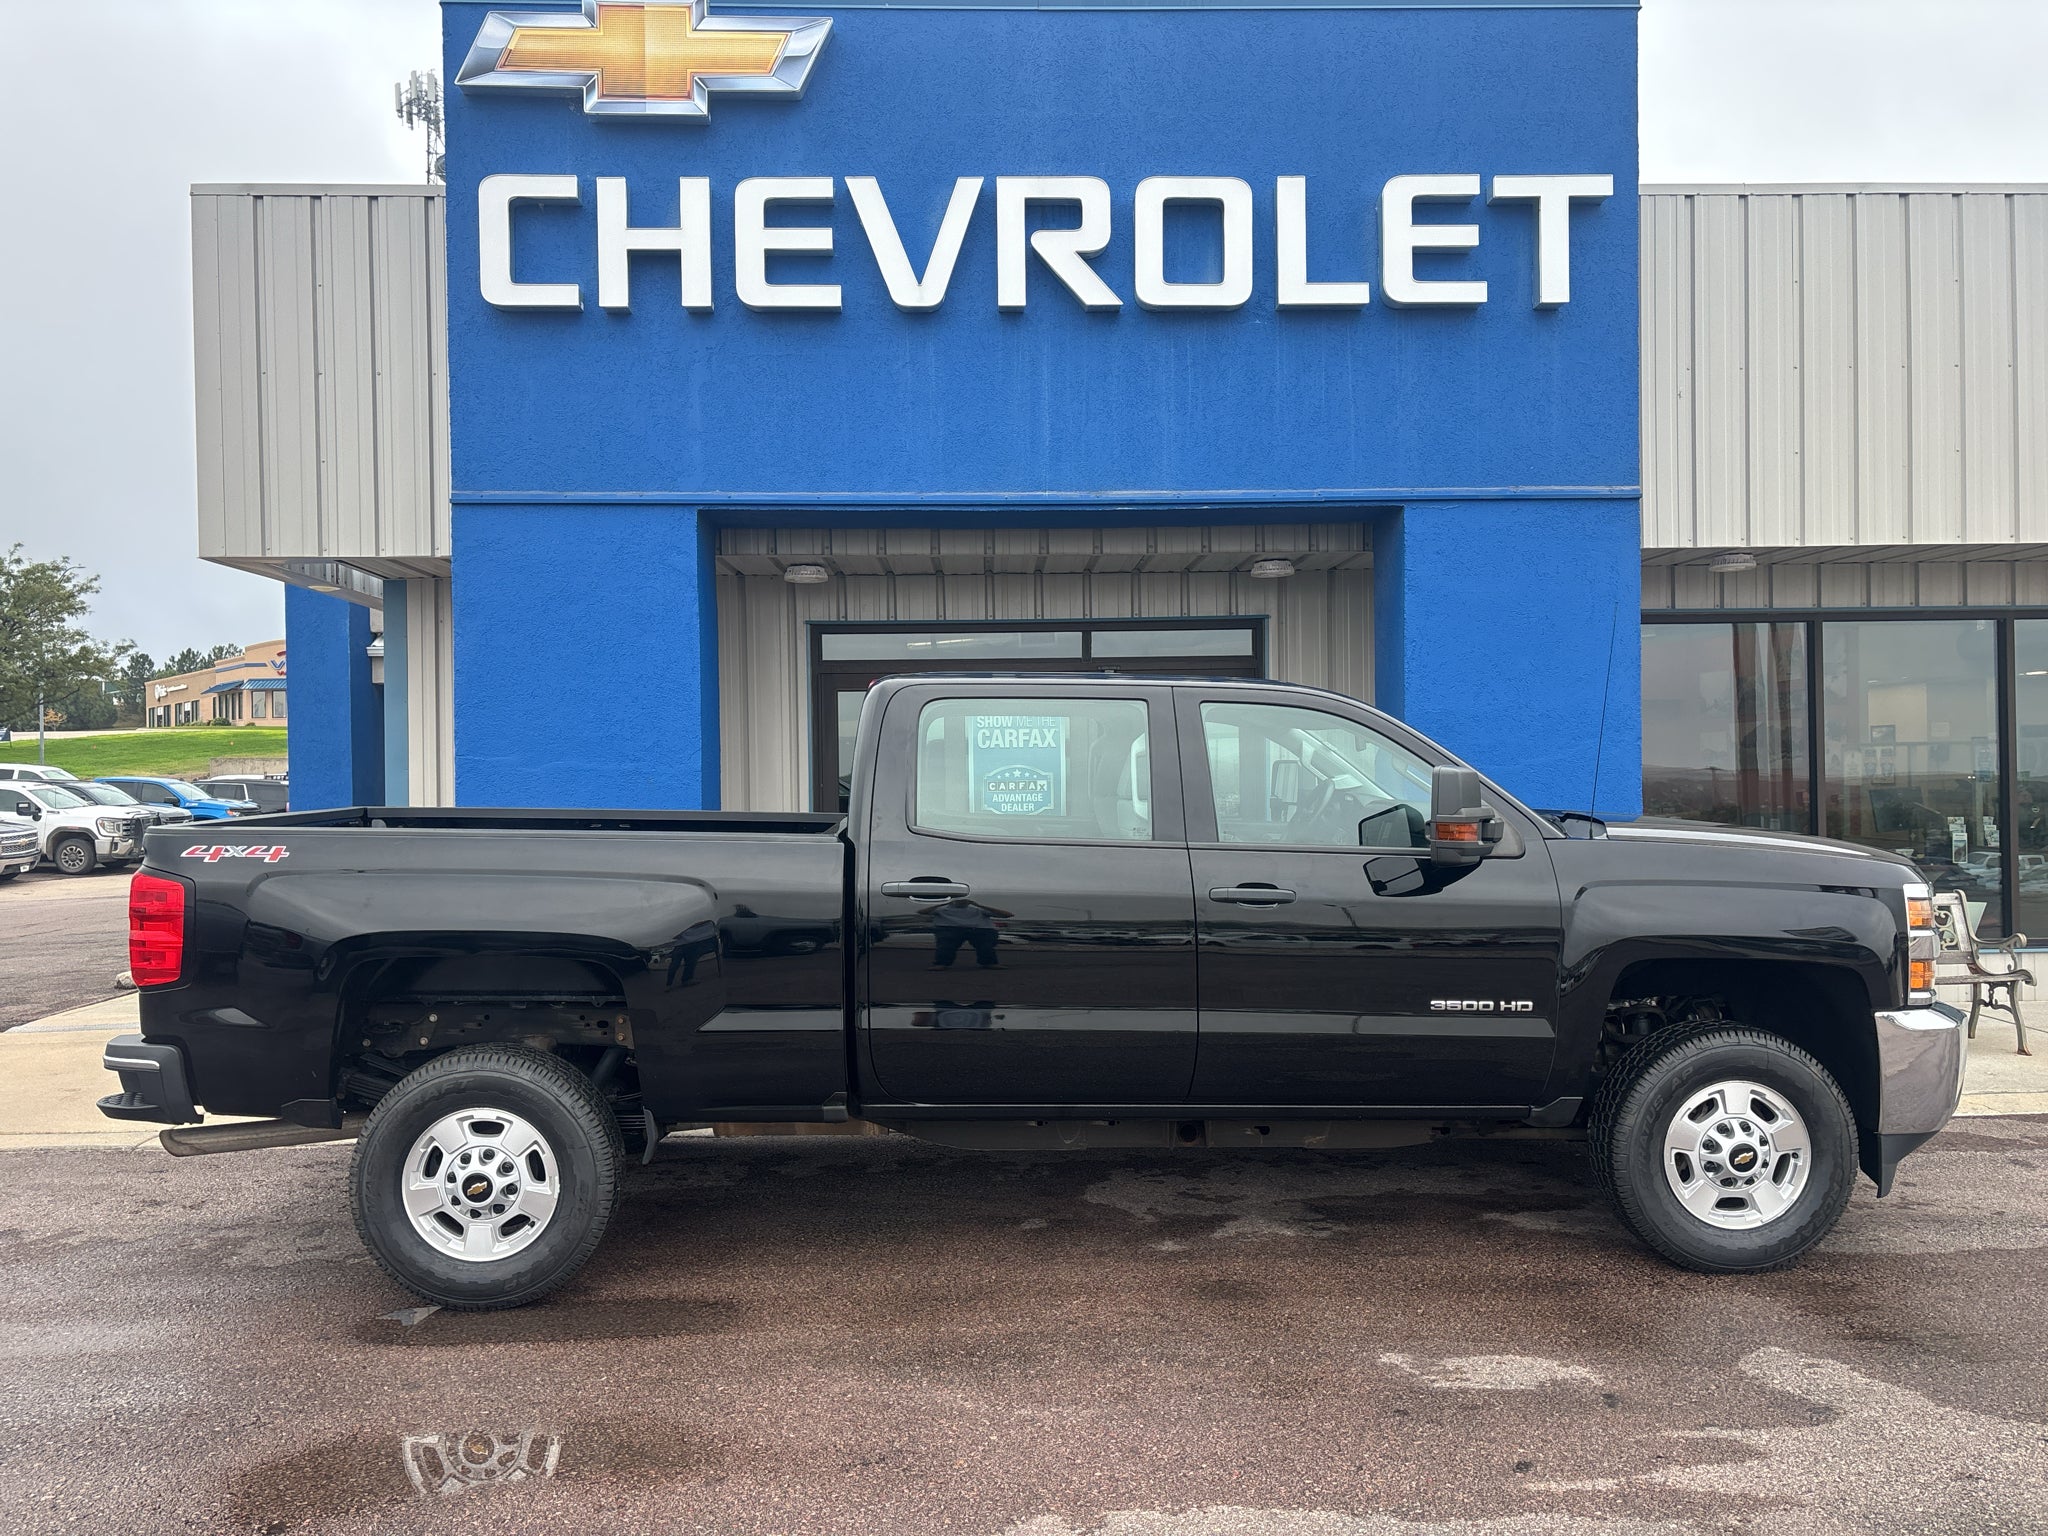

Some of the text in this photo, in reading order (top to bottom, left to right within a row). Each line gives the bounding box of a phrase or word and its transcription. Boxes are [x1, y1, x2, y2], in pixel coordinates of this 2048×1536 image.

[477, 173, 1615, 311] CHEVROLET
[977, 716, 1013, 728] SHOW
[1016, 716, 1033, 727] ME
[977, 728, 1057, 749] CARFAX
[988, 781, 1047, 792] CARFAX
[992, 793, 1044, 803] ADVANTAGE
[1001, 803, 1035, 813] DEALER
[1430, 1000, 1534, 1012] 3500 HD
